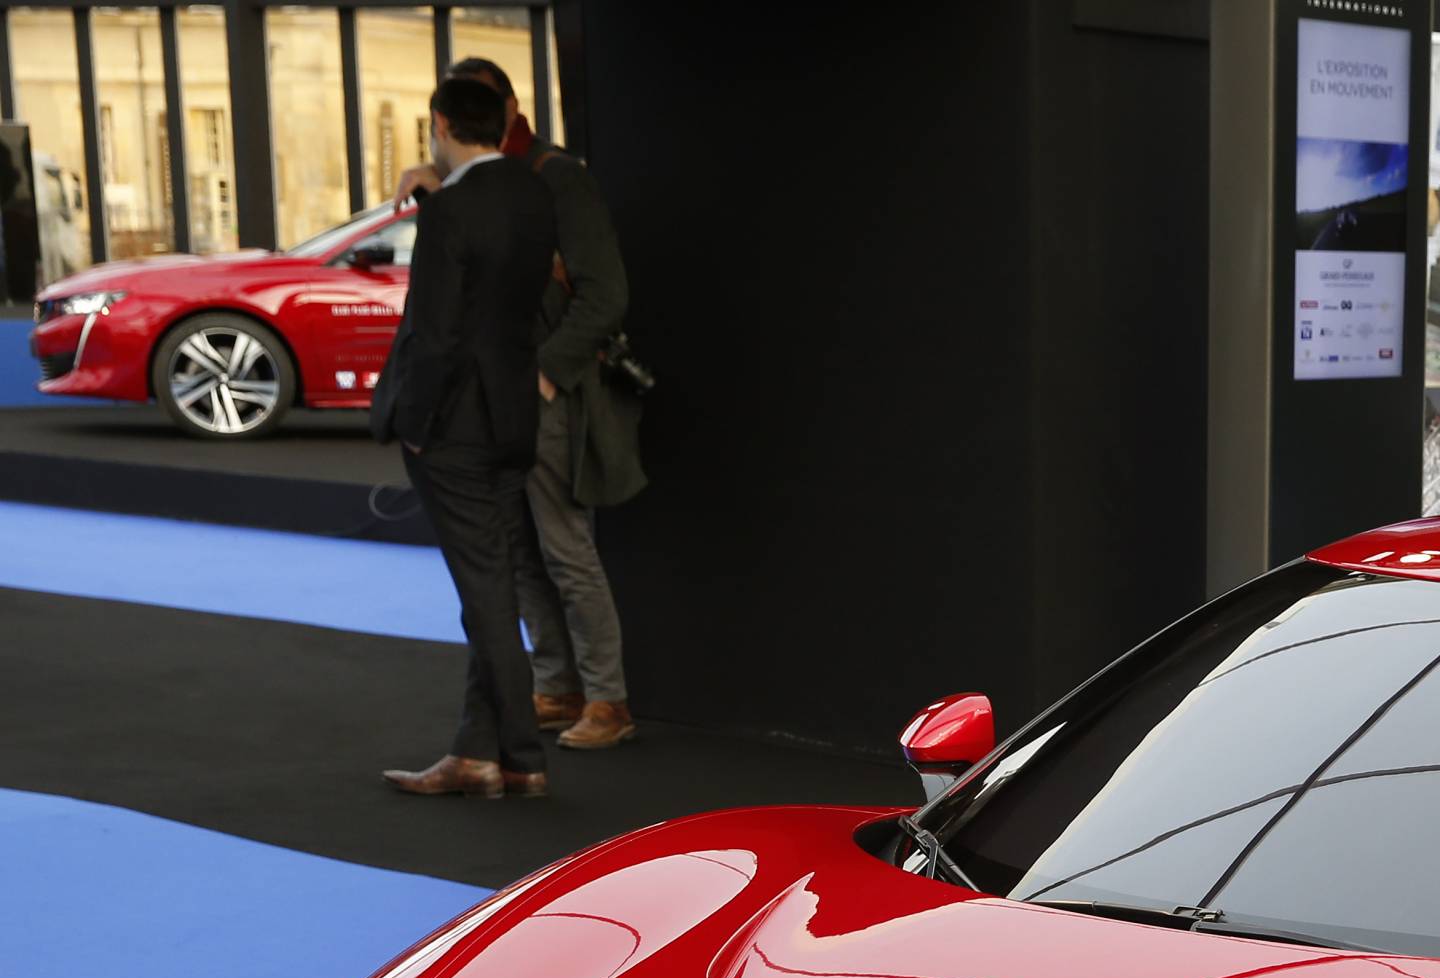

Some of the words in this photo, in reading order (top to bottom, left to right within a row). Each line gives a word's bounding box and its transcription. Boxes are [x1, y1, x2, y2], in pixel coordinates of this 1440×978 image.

[1317, 60, 1388, 80] L'EXPOSITION
[1310, 79, 1325, 95] EN
[1327, 81, 1393, 100] MOUVEMENT
